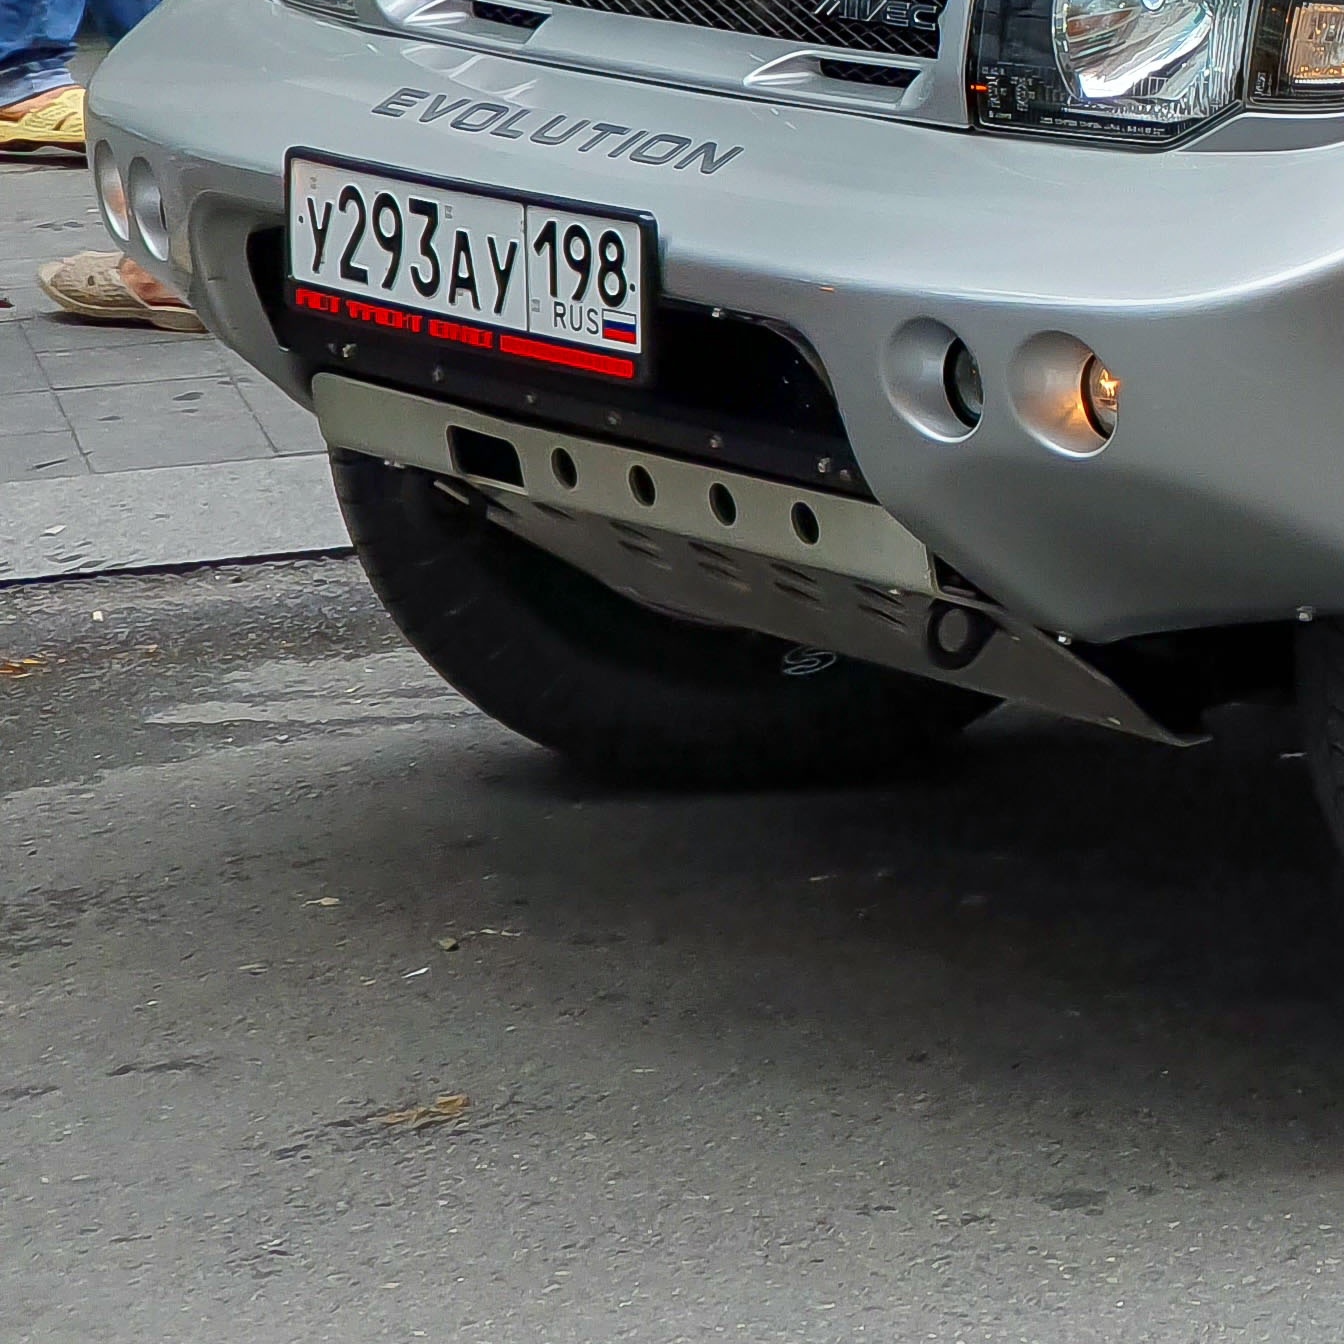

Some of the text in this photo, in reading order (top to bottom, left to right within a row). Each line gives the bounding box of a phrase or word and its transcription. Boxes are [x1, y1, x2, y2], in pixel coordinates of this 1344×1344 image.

[371, 87, 744, 174] EVOLUTION
[533, 219, 629, 308] 198
[552, 301, 600, 335] RUS
